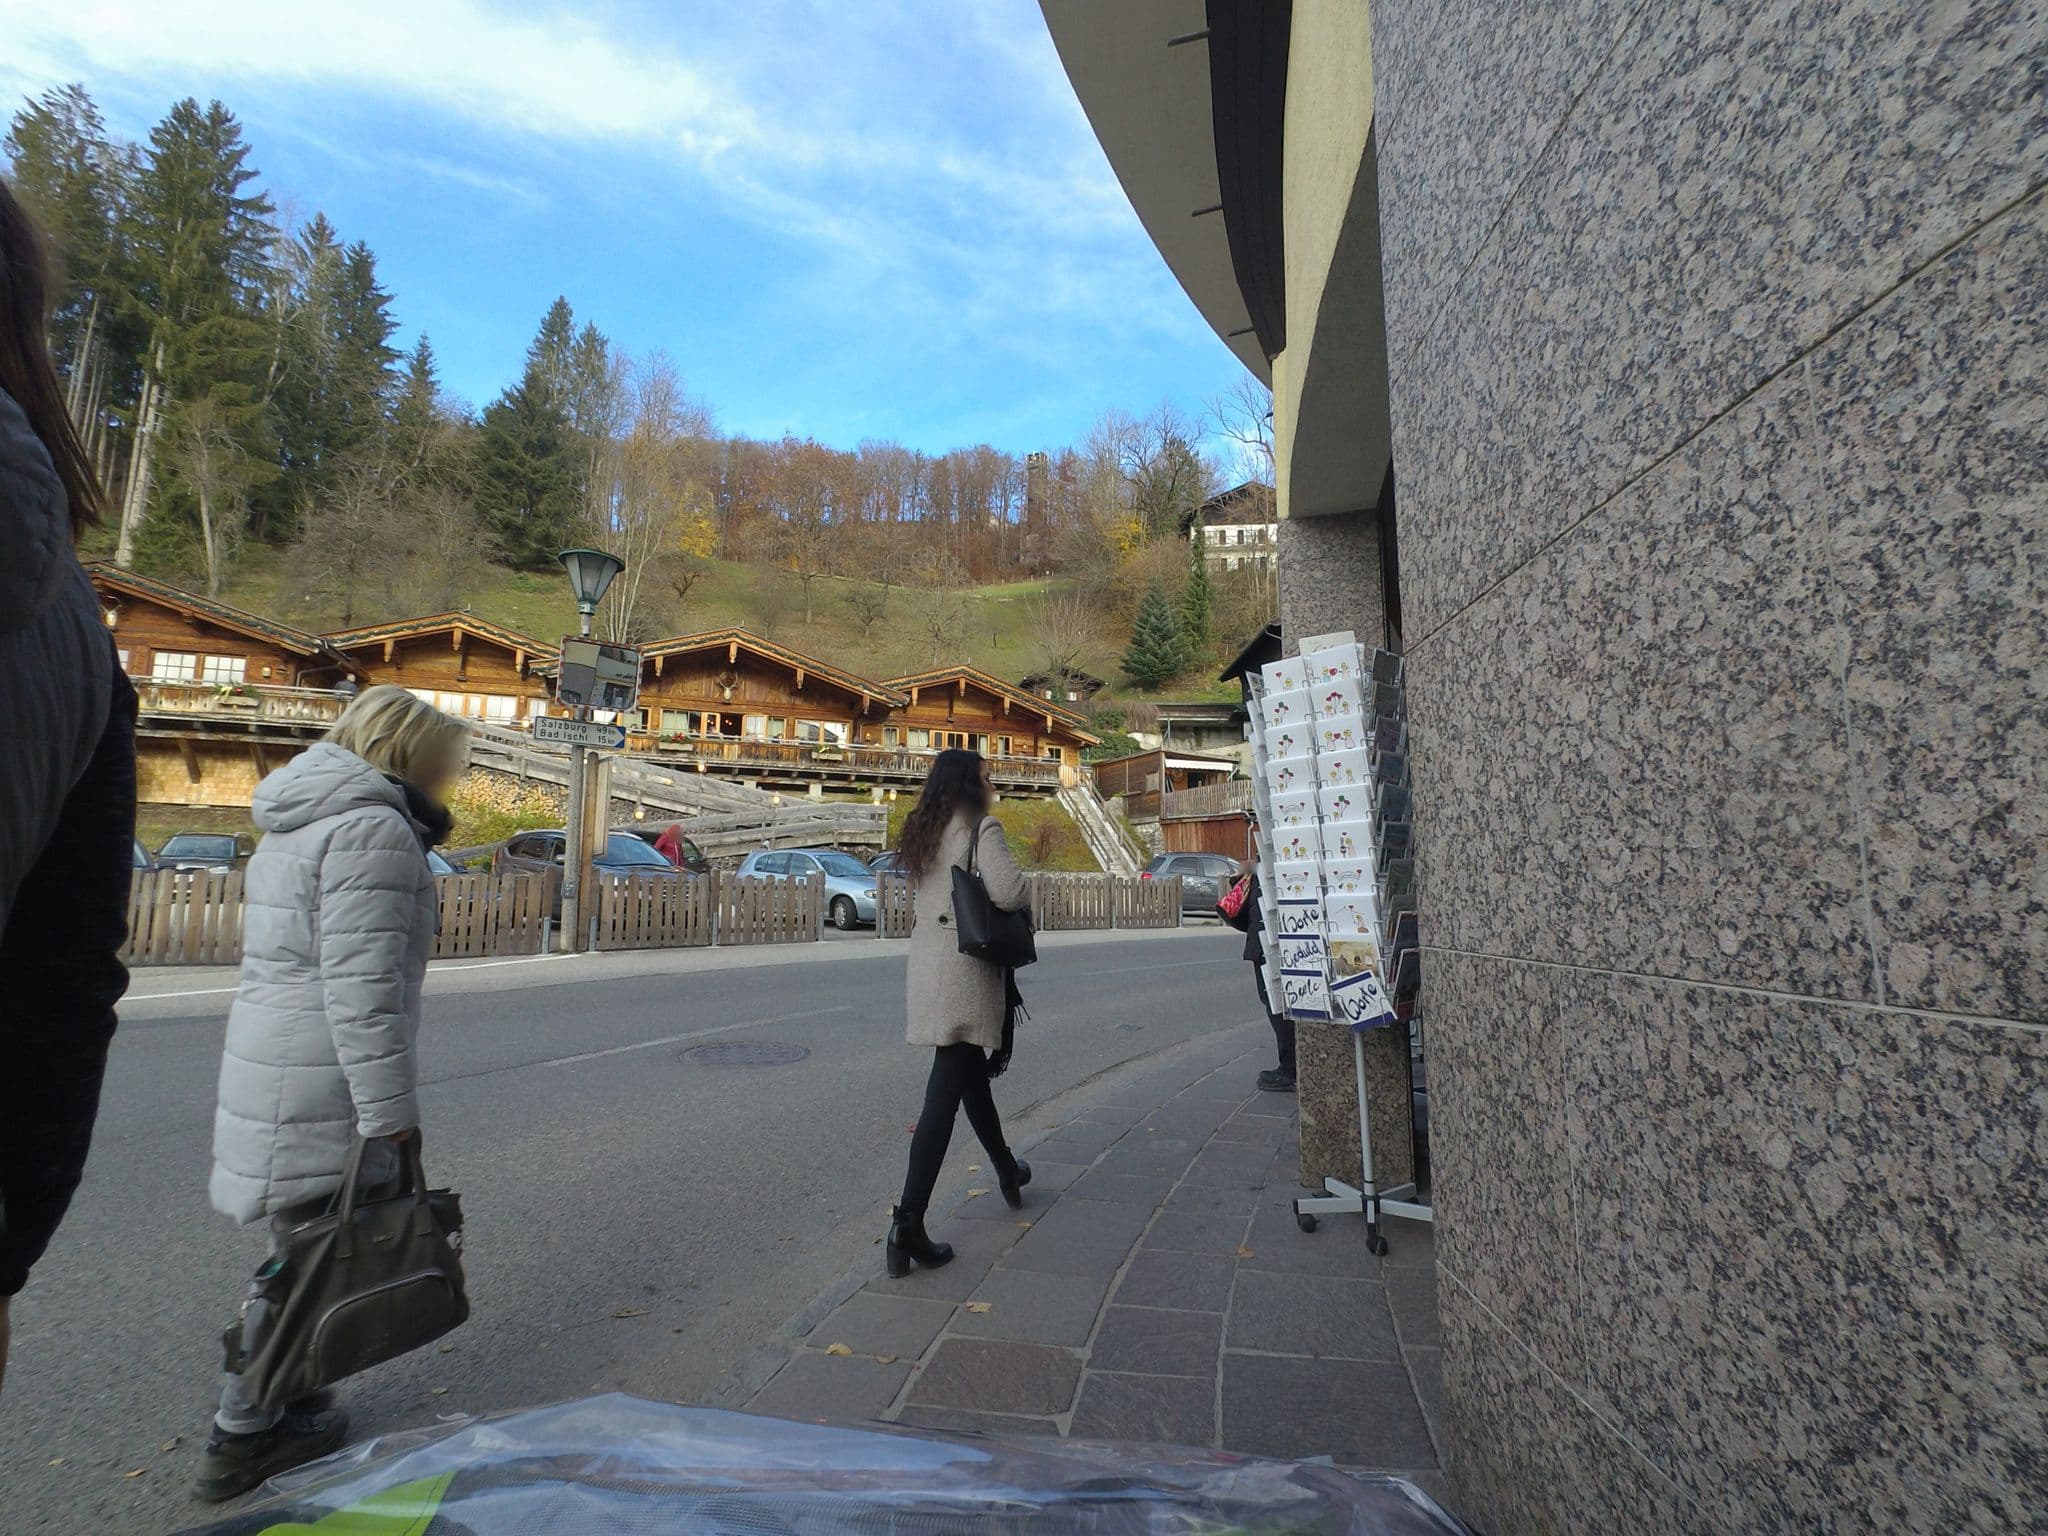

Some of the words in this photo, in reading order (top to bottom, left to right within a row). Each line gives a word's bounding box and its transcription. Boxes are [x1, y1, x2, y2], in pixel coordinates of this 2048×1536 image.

[541, 719, 587, 734] Salzburg
[596, 726, 608, 734] 49
[540, 728, 559, 739] Bad
[563, 731, 588, 742] Ischl
[598, 735, 607, 744] 15
[1342, 983, 1377, 1020] Worte
